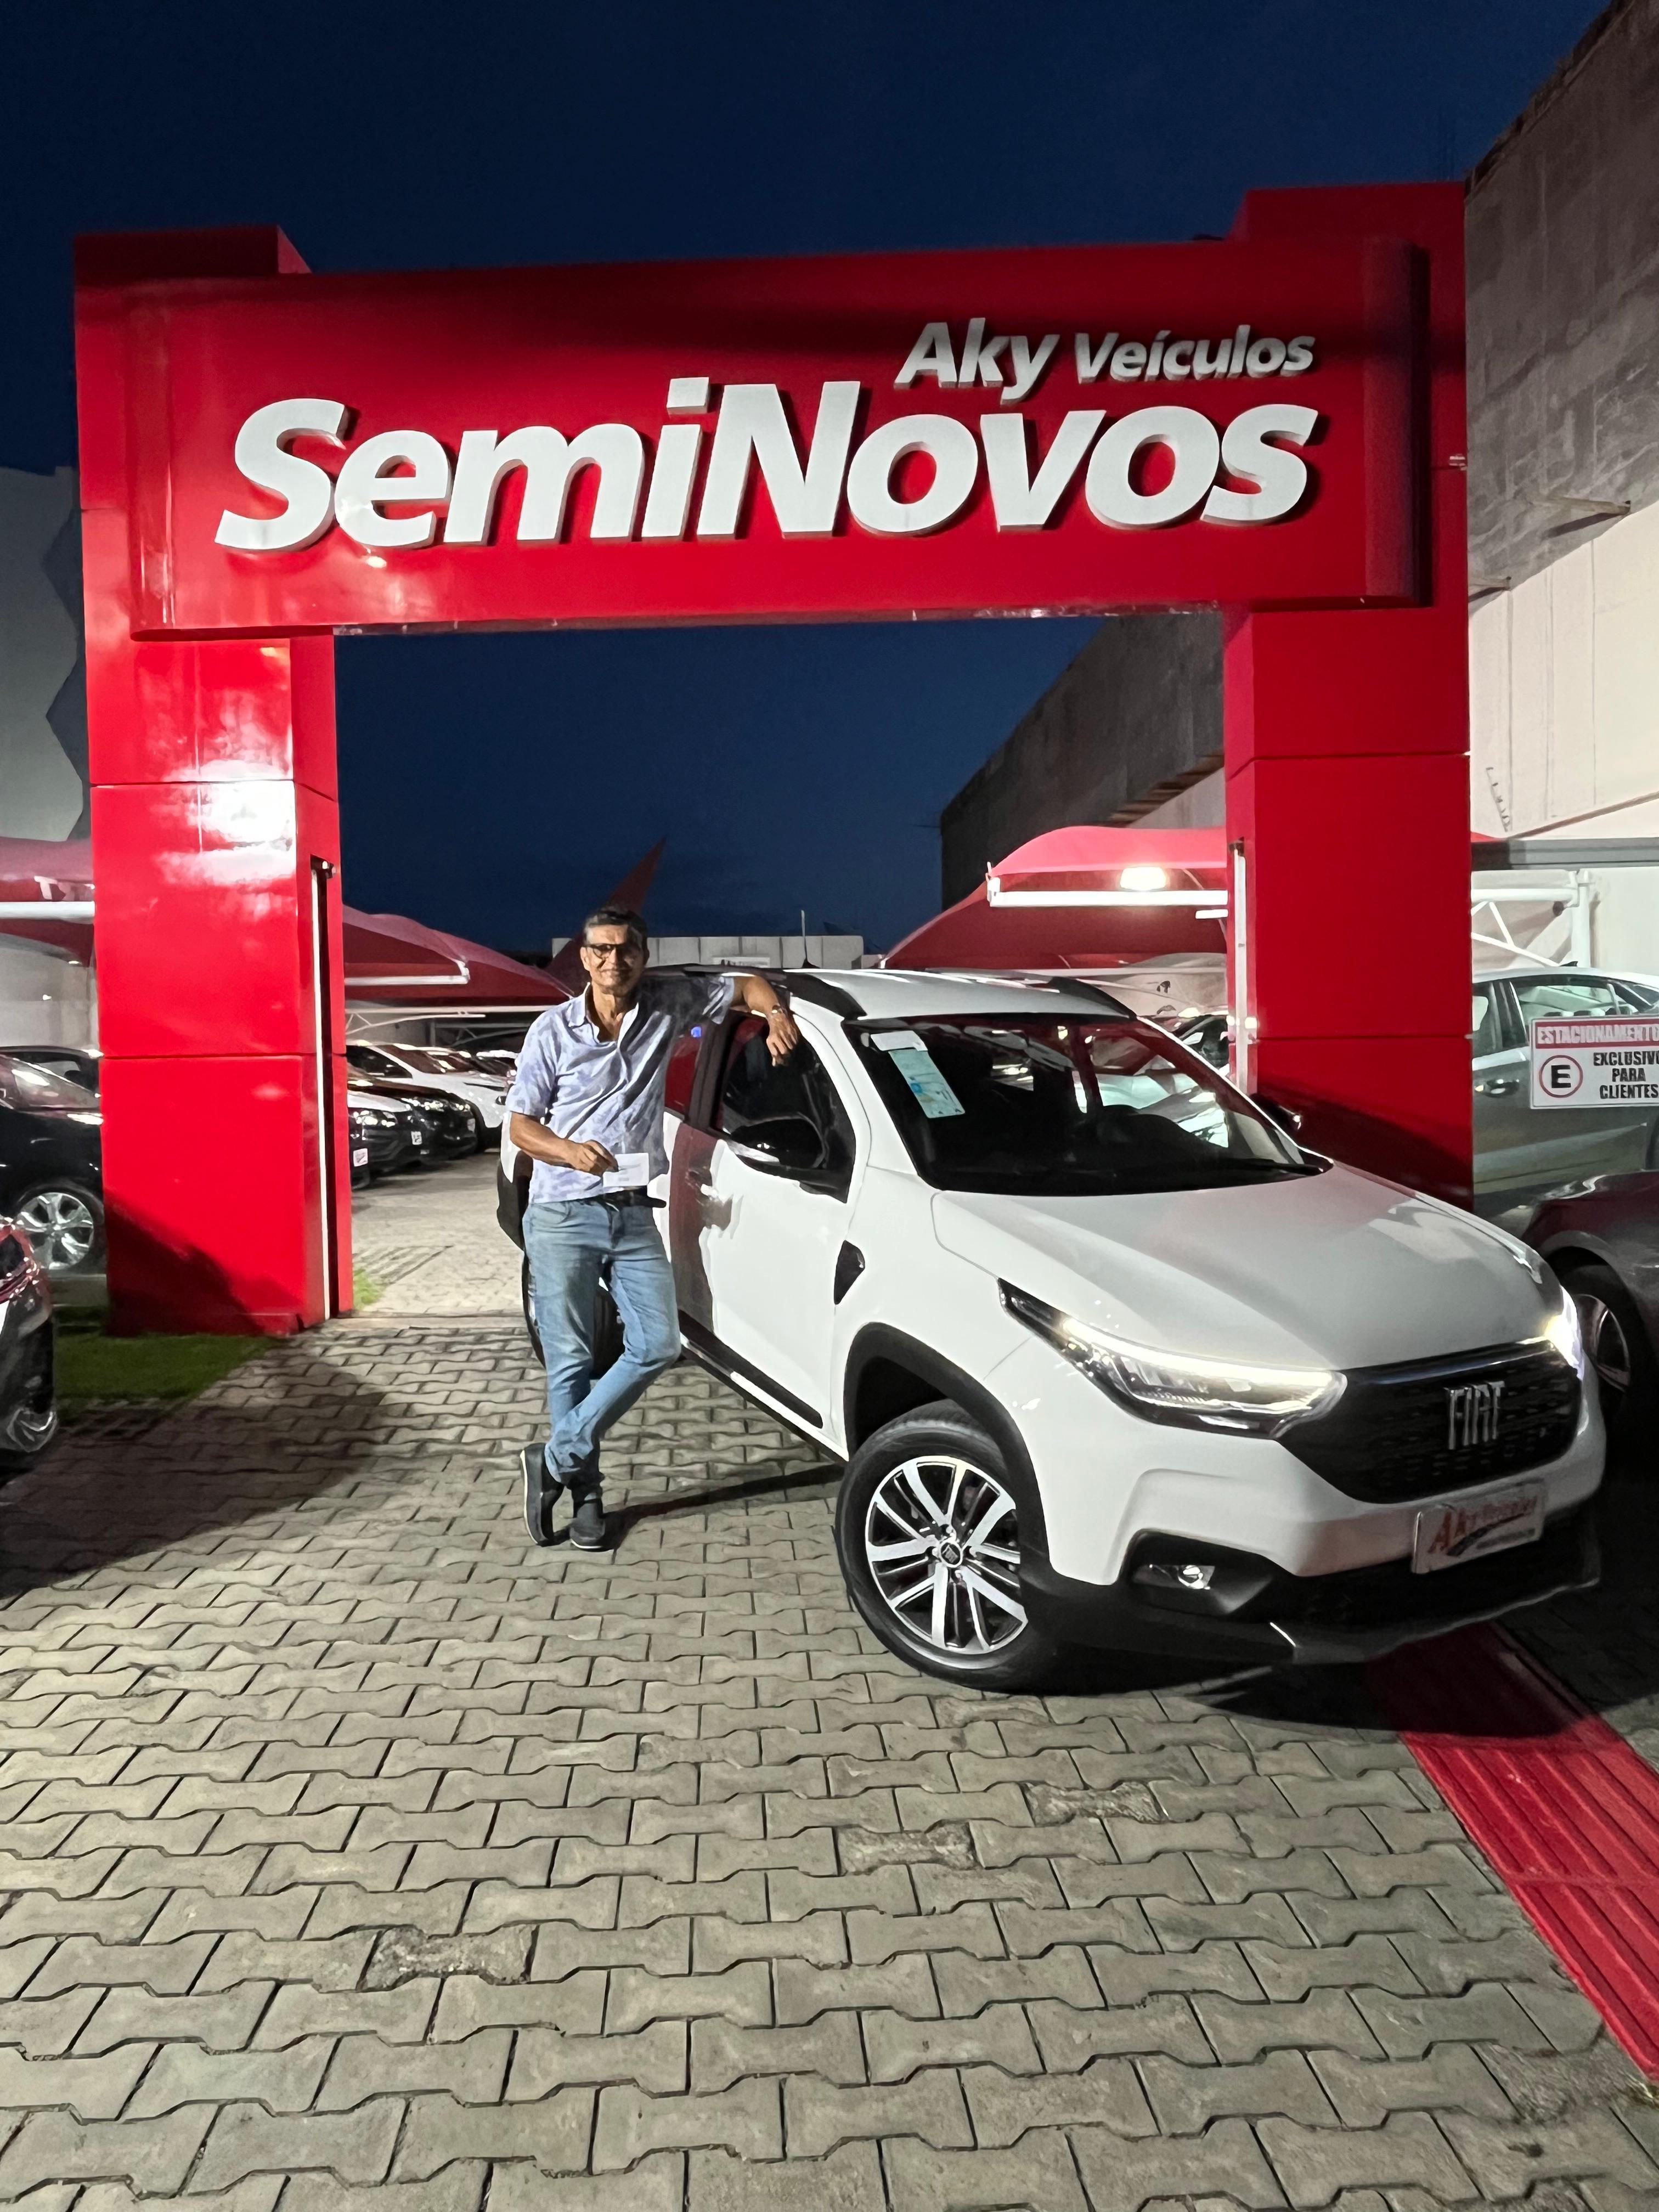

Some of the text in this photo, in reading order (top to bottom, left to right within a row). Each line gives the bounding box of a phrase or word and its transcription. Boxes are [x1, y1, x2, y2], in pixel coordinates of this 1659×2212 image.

[893, 317, 1315, 405] Aky Veículos
[215, 376, 1318, 551] SemiNovos
[1551, 1064, 1571, 1088] E
[1599, 1084, 1659, 1099] CLIENTES
[1612, 1068, 1646, 1082] PARA
[1444, 1380, 1505, 1451] FIAT
